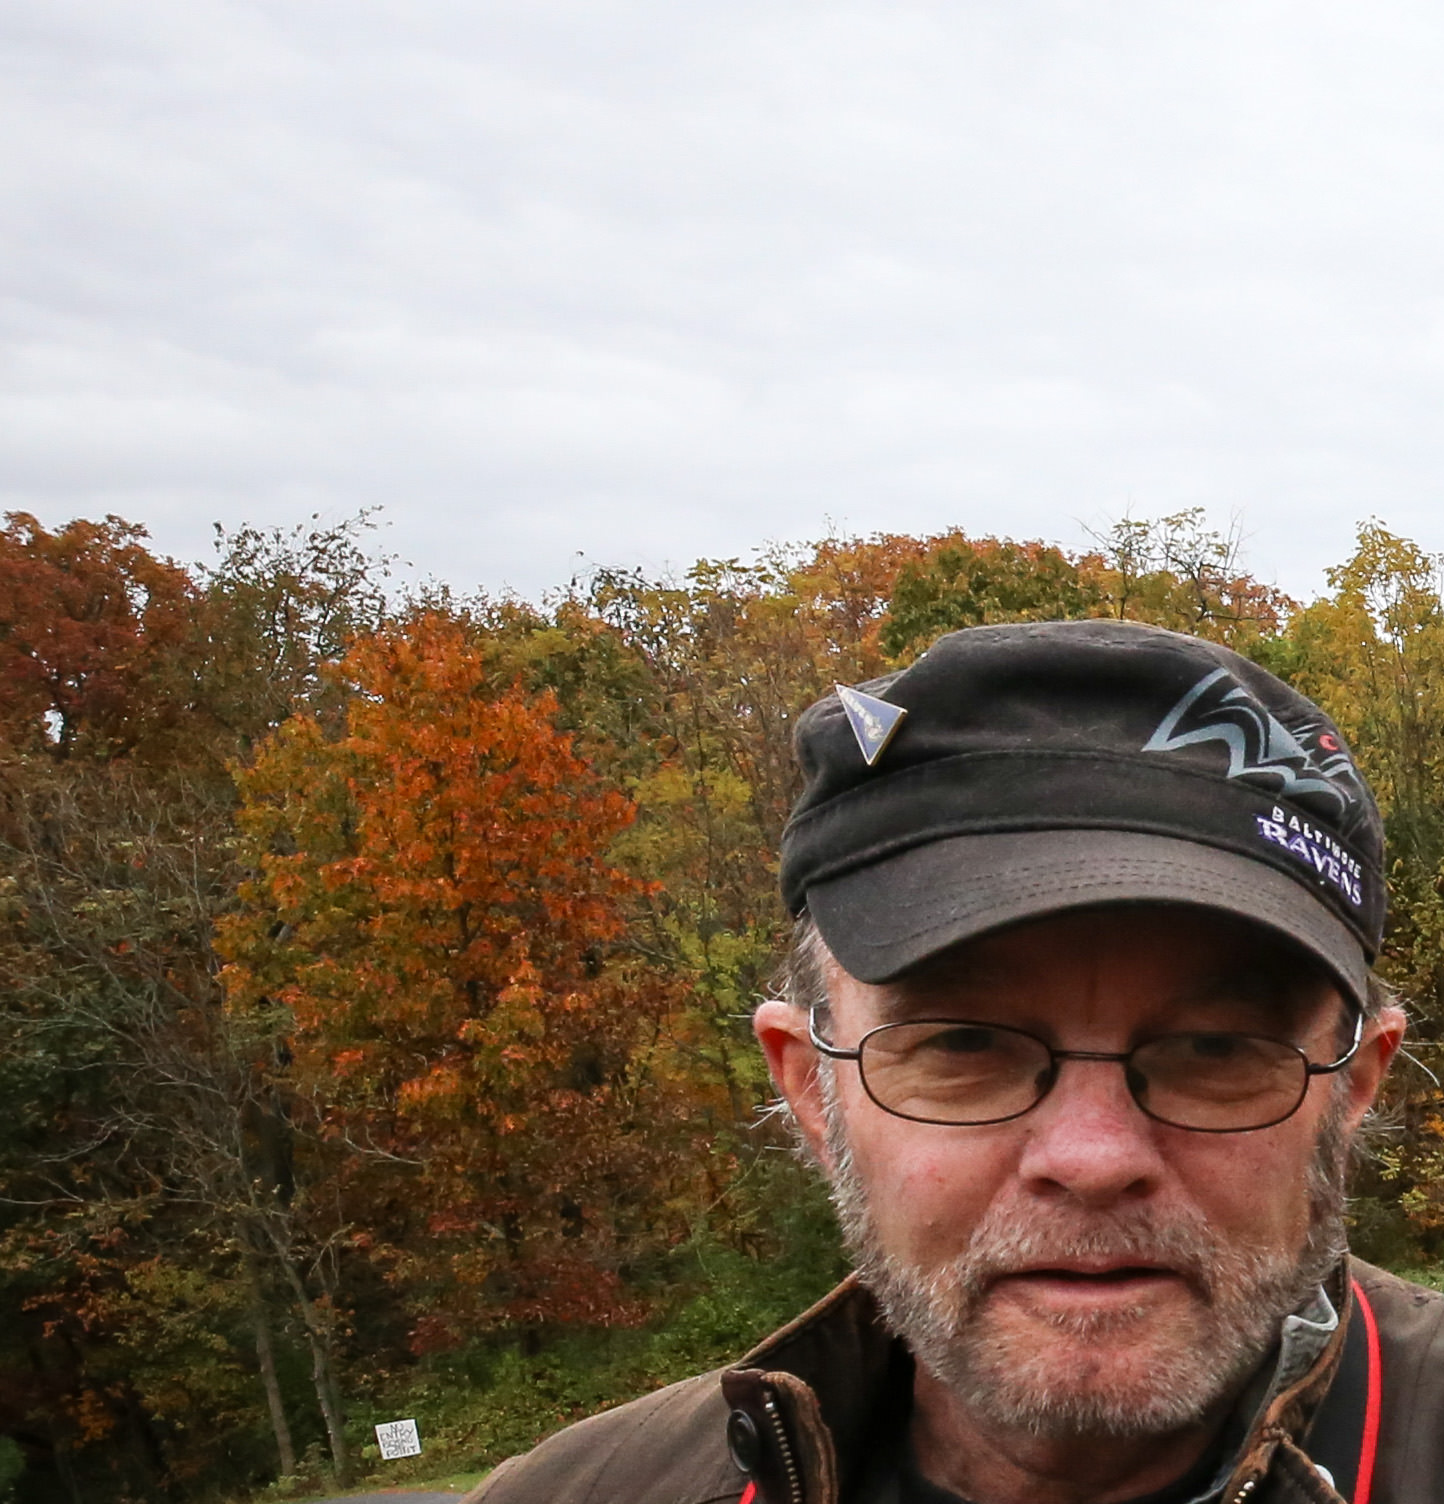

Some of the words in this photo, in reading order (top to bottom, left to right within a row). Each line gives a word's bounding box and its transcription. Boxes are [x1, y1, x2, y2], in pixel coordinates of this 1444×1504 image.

[1272, 805, 1362, 879] BALTIMORE
[1256, 815, 1363, 906] RAVENS
[380, 1428, 414, 1441] ENTRY
[390, 1423, 404, 1433] NO
[386, 1446, 417, 1457] POINT
